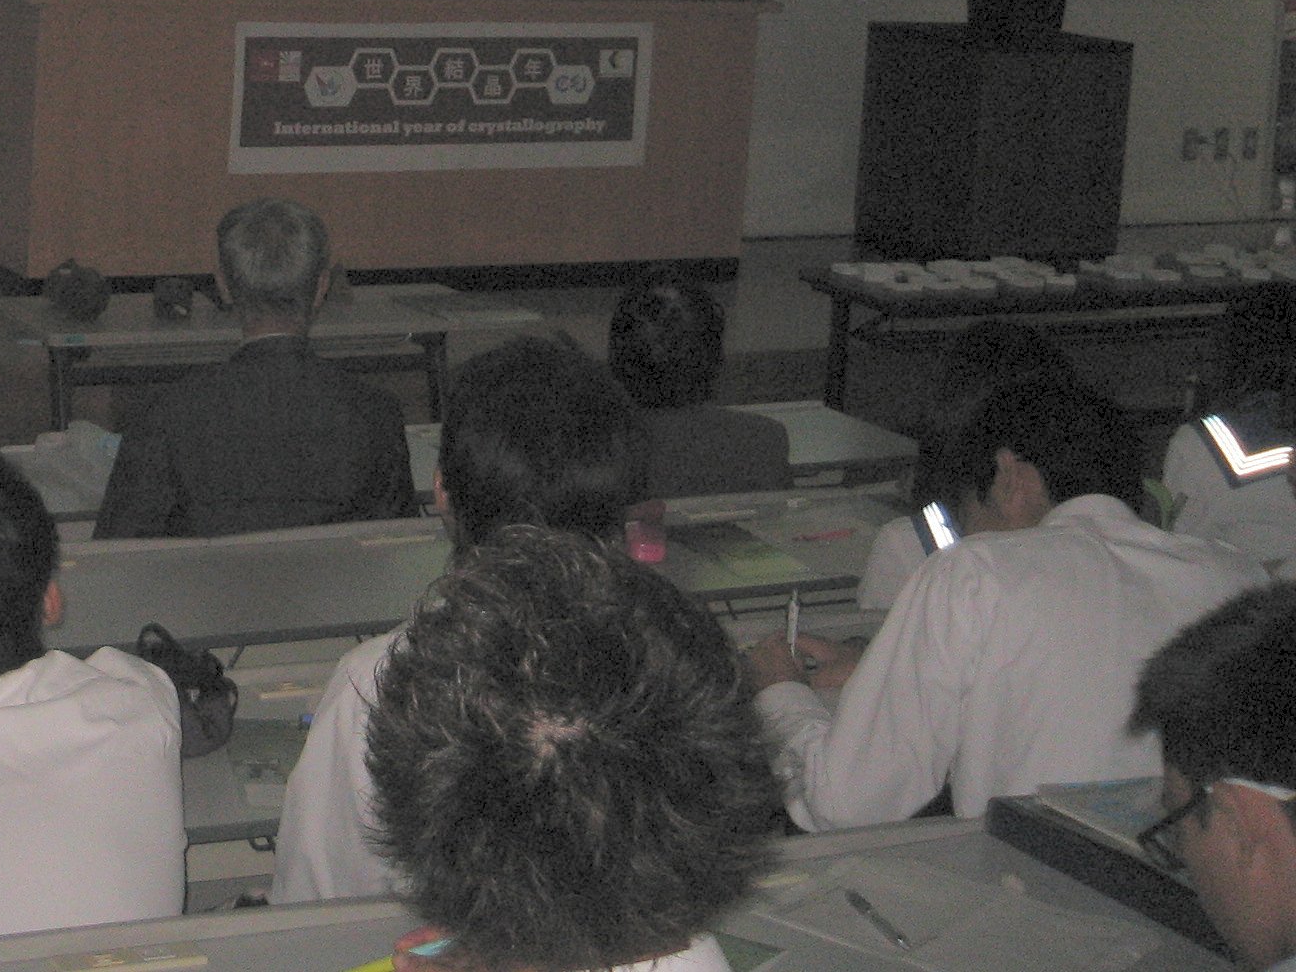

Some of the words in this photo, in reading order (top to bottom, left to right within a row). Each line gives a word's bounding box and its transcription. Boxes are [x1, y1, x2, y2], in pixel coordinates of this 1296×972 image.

[273, 120, 399, 136] International
[402, 122, 443, 137] year
[446, 119, 466, 134] of
